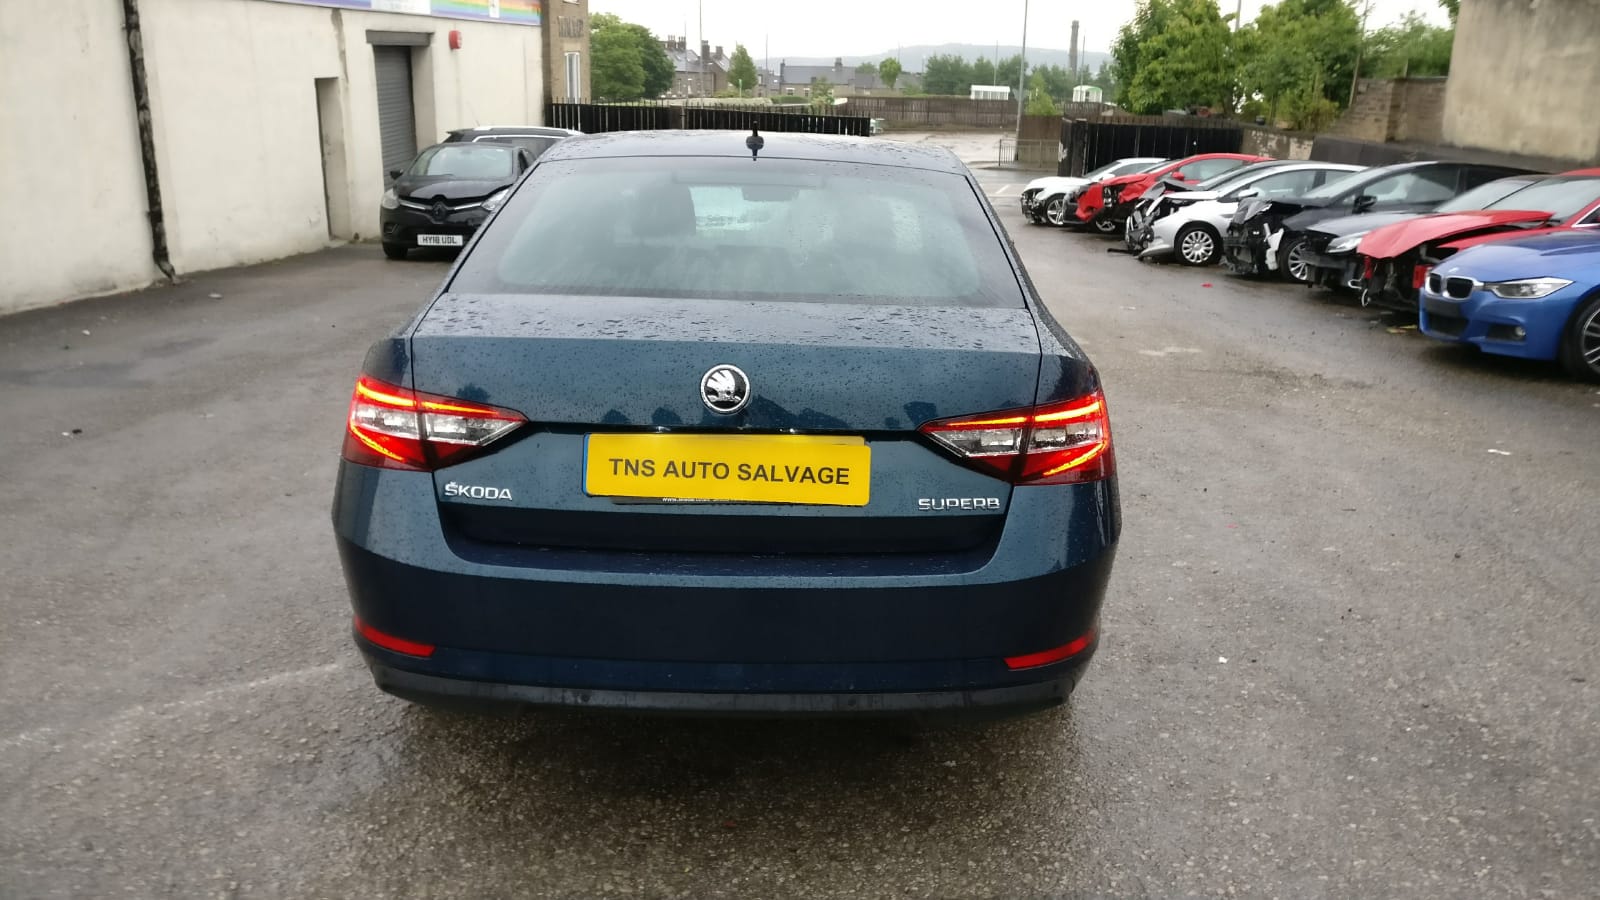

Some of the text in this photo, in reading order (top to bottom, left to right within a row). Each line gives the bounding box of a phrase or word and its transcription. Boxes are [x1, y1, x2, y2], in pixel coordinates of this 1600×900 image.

[609, 458, 850, 486] TNS AUTO SALVAGE
[444, 481, 513, 501] ŠKODA
[918, 497, 1001, 511] SUPERB
